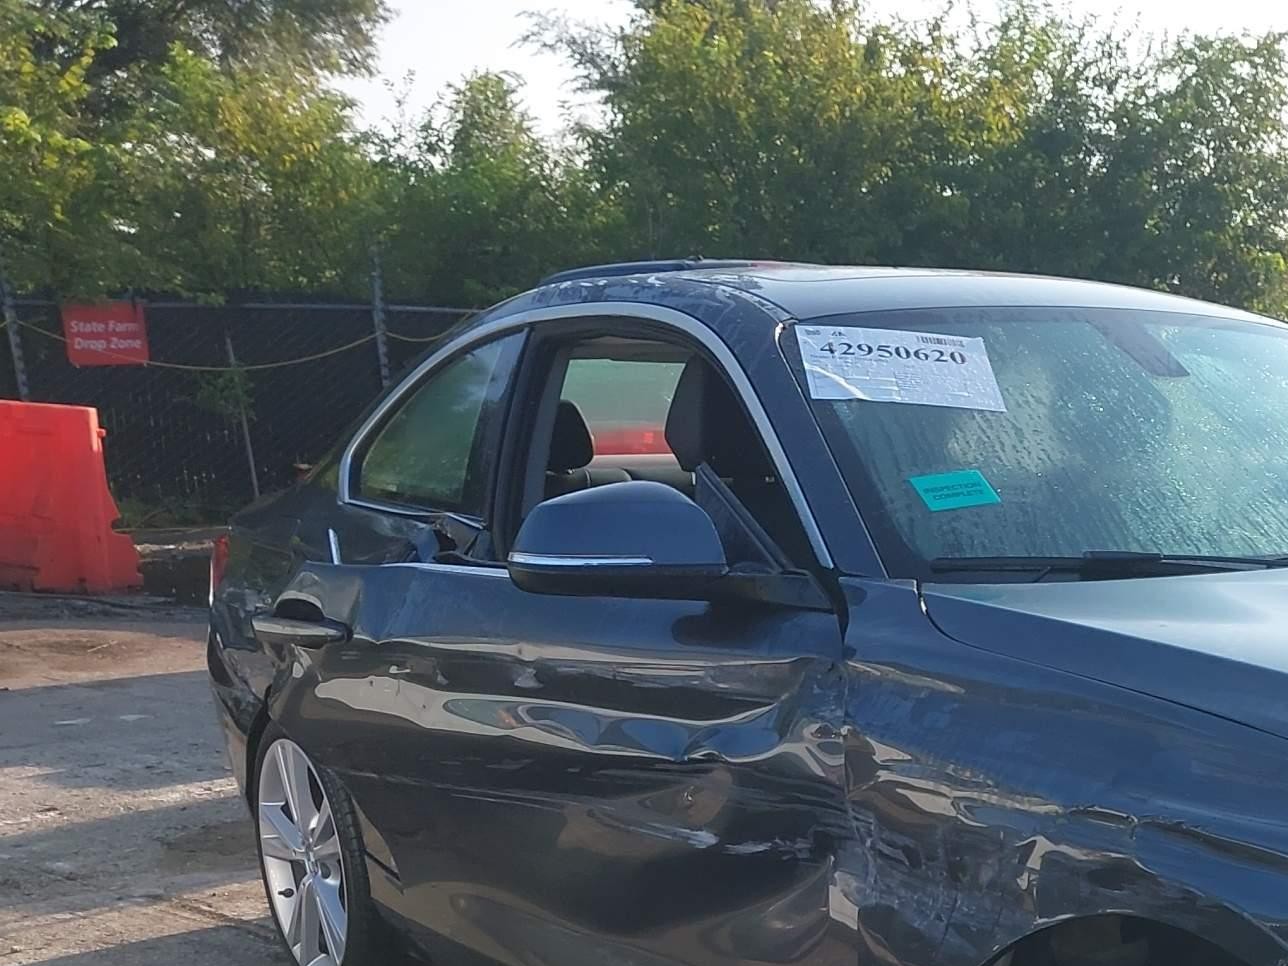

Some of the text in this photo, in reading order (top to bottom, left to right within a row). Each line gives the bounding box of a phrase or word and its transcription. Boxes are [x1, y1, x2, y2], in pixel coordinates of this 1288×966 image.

[69, 320, 139, 333] State Farm
[74, 337, 142, 351] Drop Zone
[819, 341, 967, 365] 42950620
